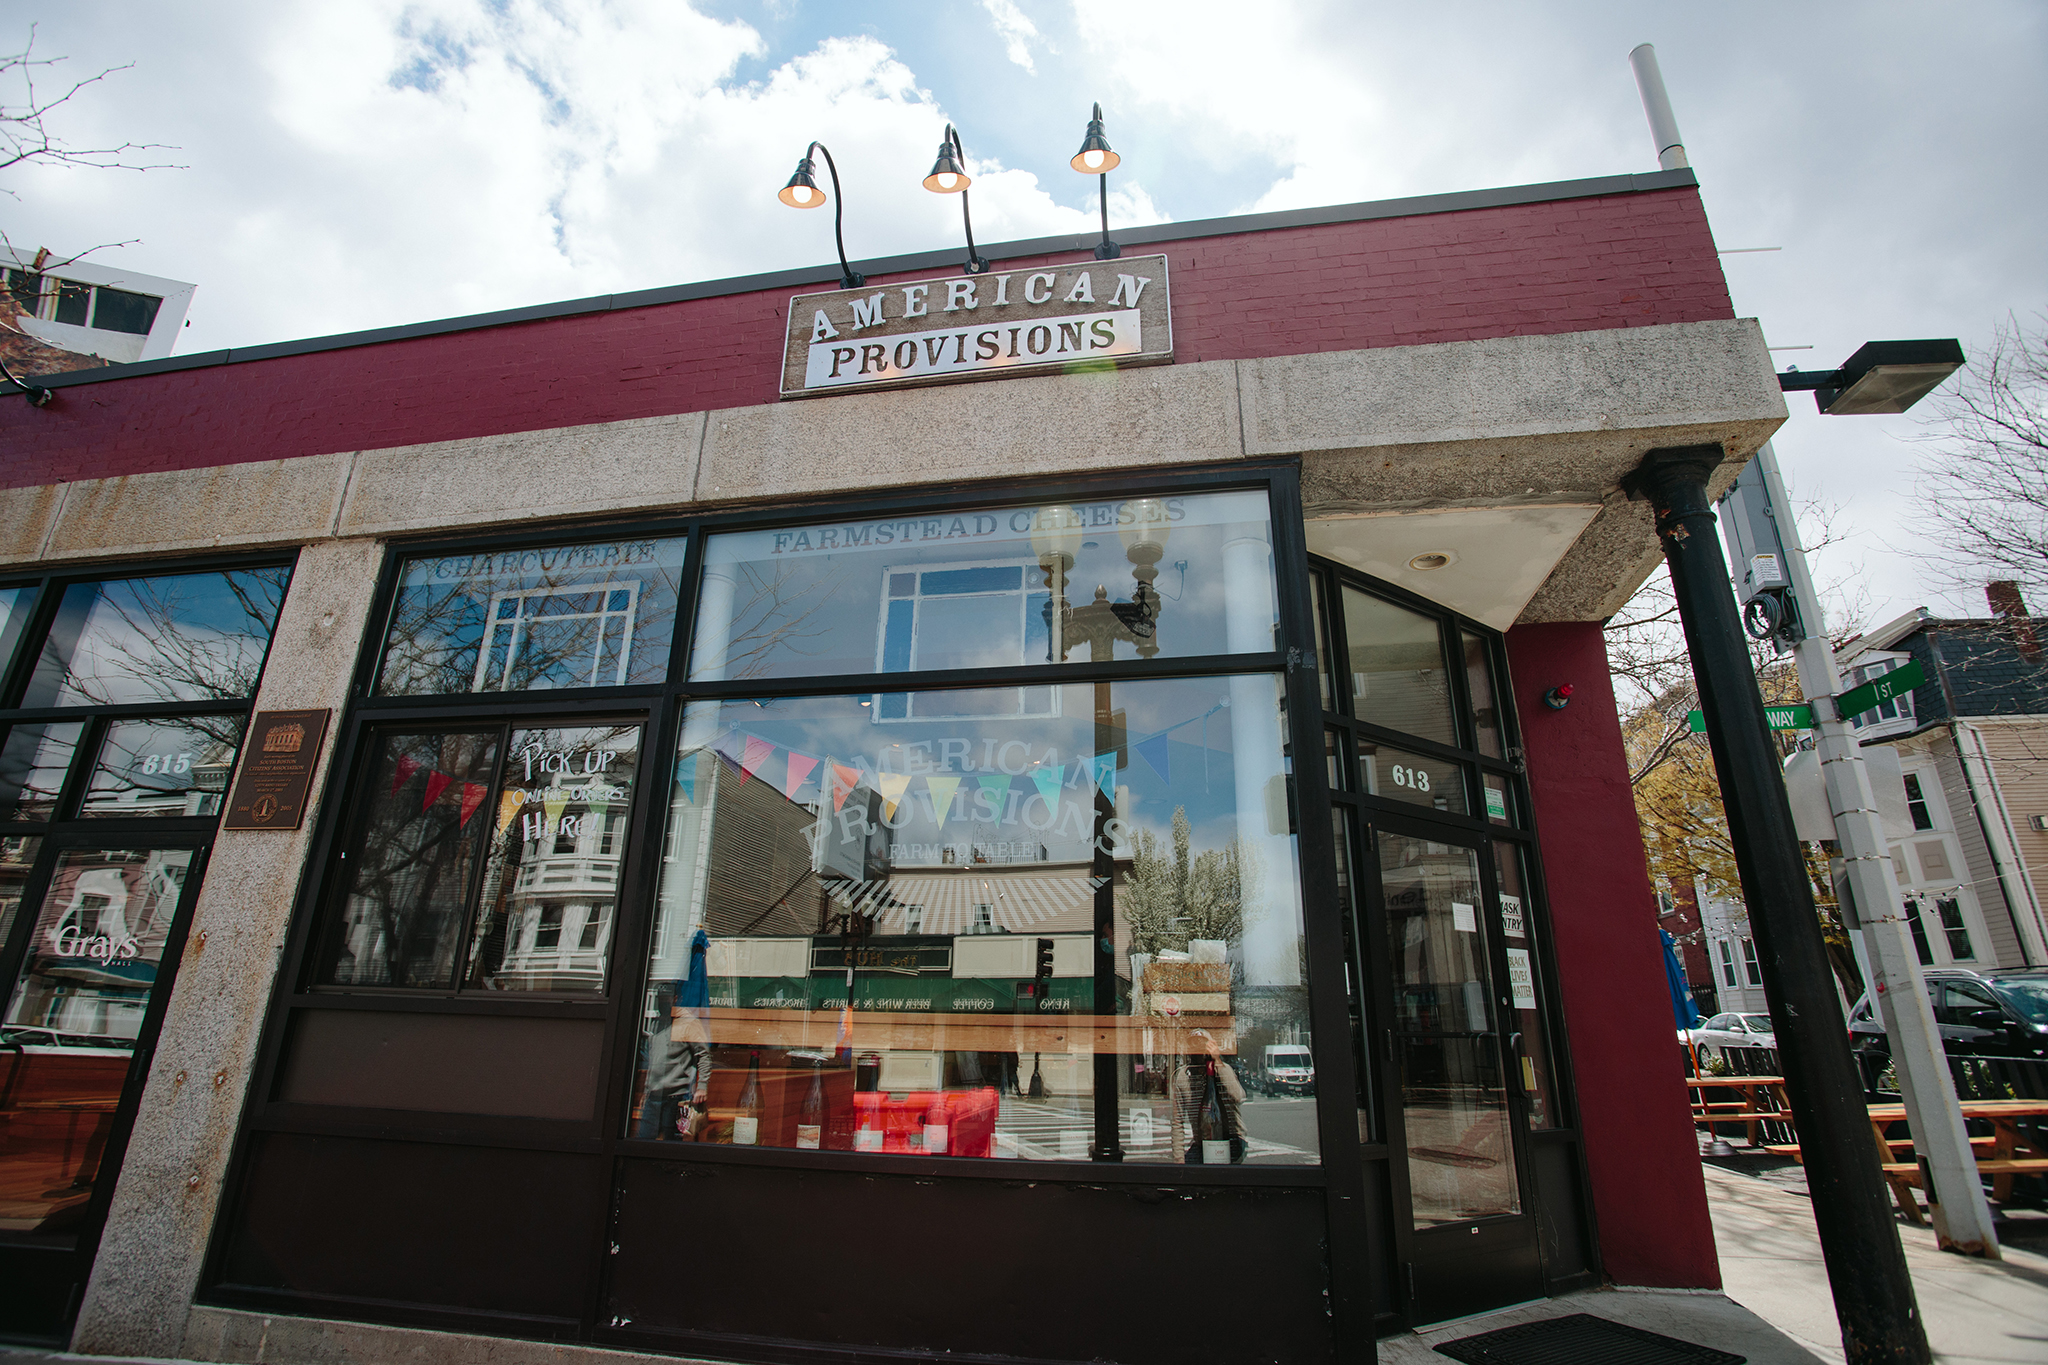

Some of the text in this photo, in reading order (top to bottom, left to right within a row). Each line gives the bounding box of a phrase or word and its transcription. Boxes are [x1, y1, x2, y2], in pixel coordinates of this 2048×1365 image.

[809, 272, 1151, 343] AMERICAN
[828, 318, 1115, 378] PROVISIONS
[770, 499, 1186, 554] FARMSTEAD CHEESES
[435, 544, 656, 579] CHARCUTERIE
[1880, 682, 1893, 698] ST
[1766, 710, 1796, 727] WAY
[142, 753, 191, 775] 615
[584, 750, 617, 774] UP
[831, 737, 1118, 798] AMERICAN
[1392, 764, 1431, 792] 613
[570, 784, 625, 801] ORDERS
[522, 811, 601, 842] HERE!
[800, 785, 1138, 862] PROVISIONS
[889, 842, 1036, 860] FARM TO TABLE
[1503, 918, 1522, 930] NTRY
[1508, 956, 1525, 968] BLACK
[1511, 970, 1527, 981] LIVES
